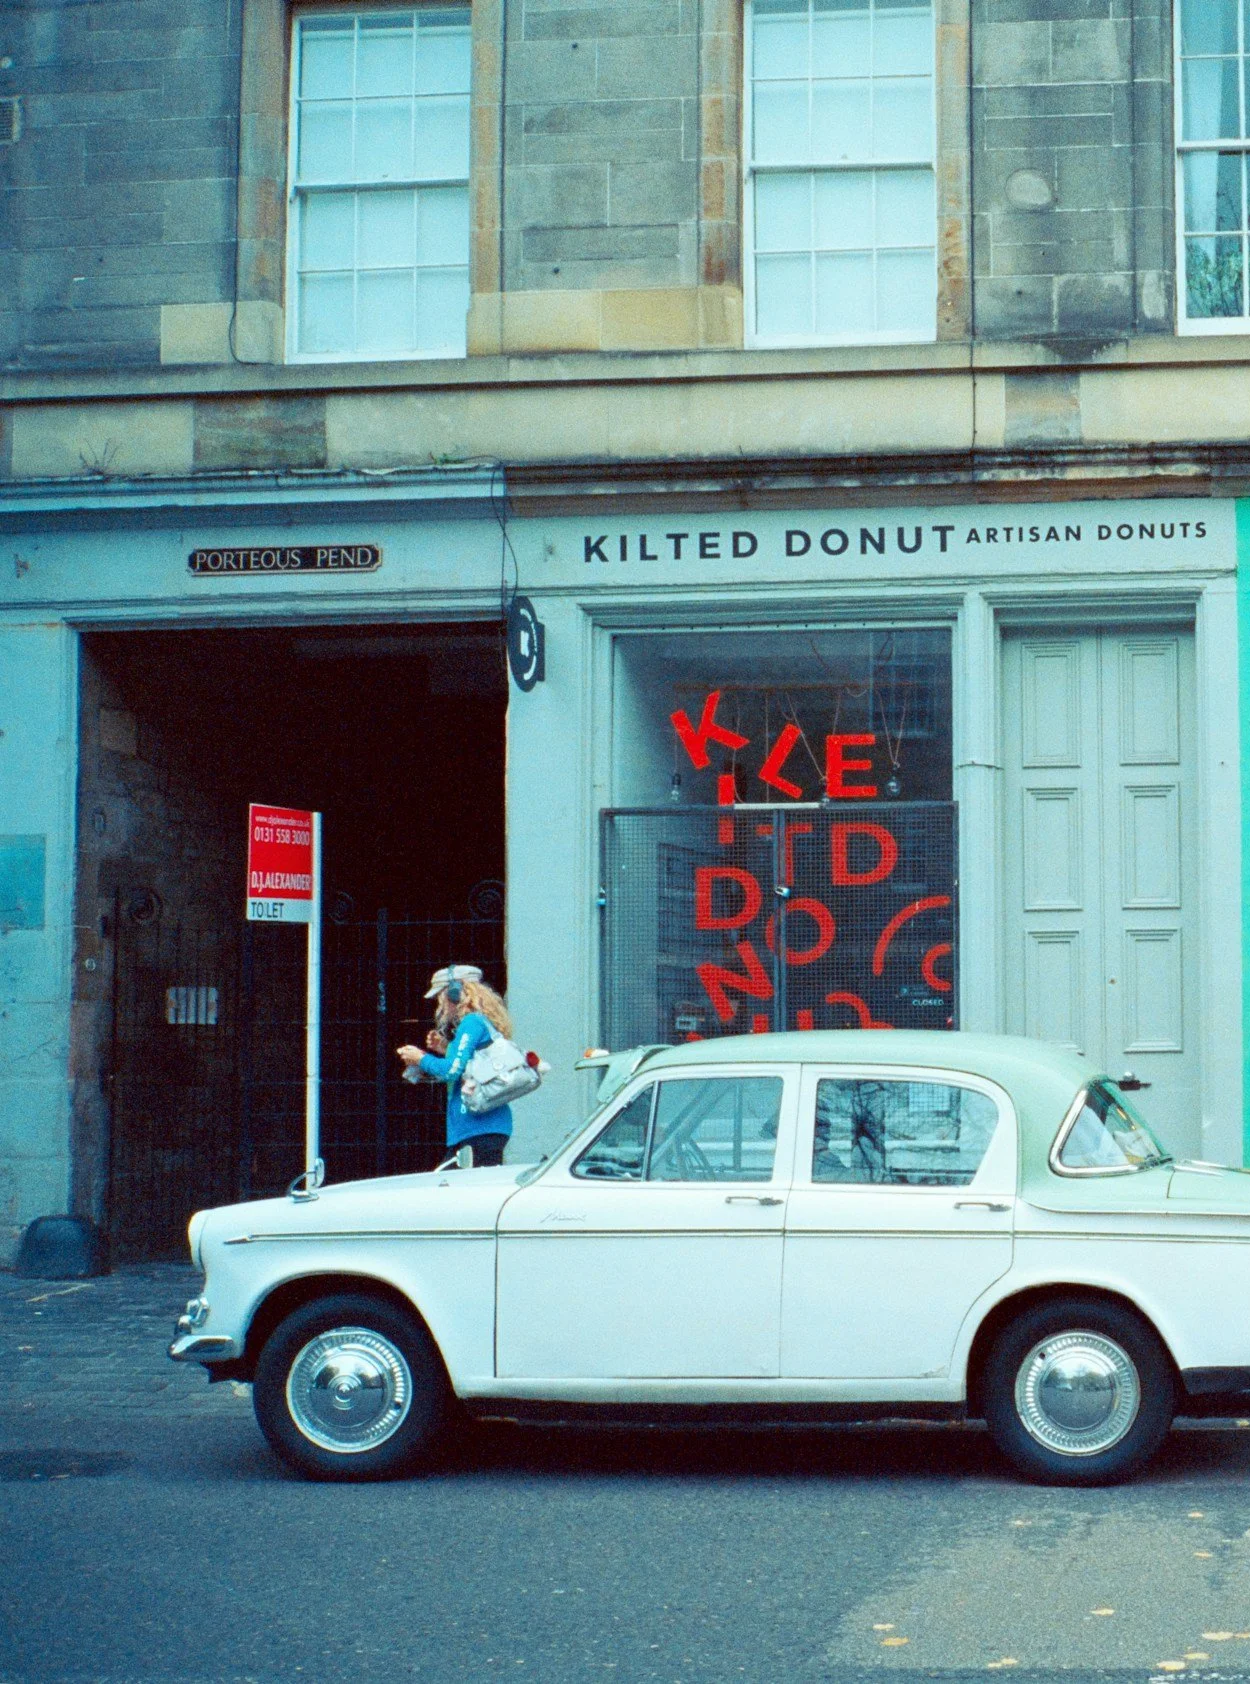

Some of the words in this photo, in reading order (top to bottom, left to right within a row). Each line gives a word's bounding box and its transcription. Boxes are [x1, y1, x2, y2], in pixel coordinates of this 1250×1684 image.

[965, 525, 1082, 544] ARTISAN
[1097, 521, 1208, 541] DONUTS
[583, 531, 760, 563] KILTED
[784, 525, 956, 558] DONUT
[194, 549, 301, 571] PORTEOUS
[316, 547, 373, 567] PEND
[254, 826, 274, 843] 0131
[275, 828, 291, 845] 558
[291, 829, 311, 846] 3000
[251, 901, 264, 919] TO
[266, 902, 285, 919] LET
[911, 998, 945, 1007] CLOSED
